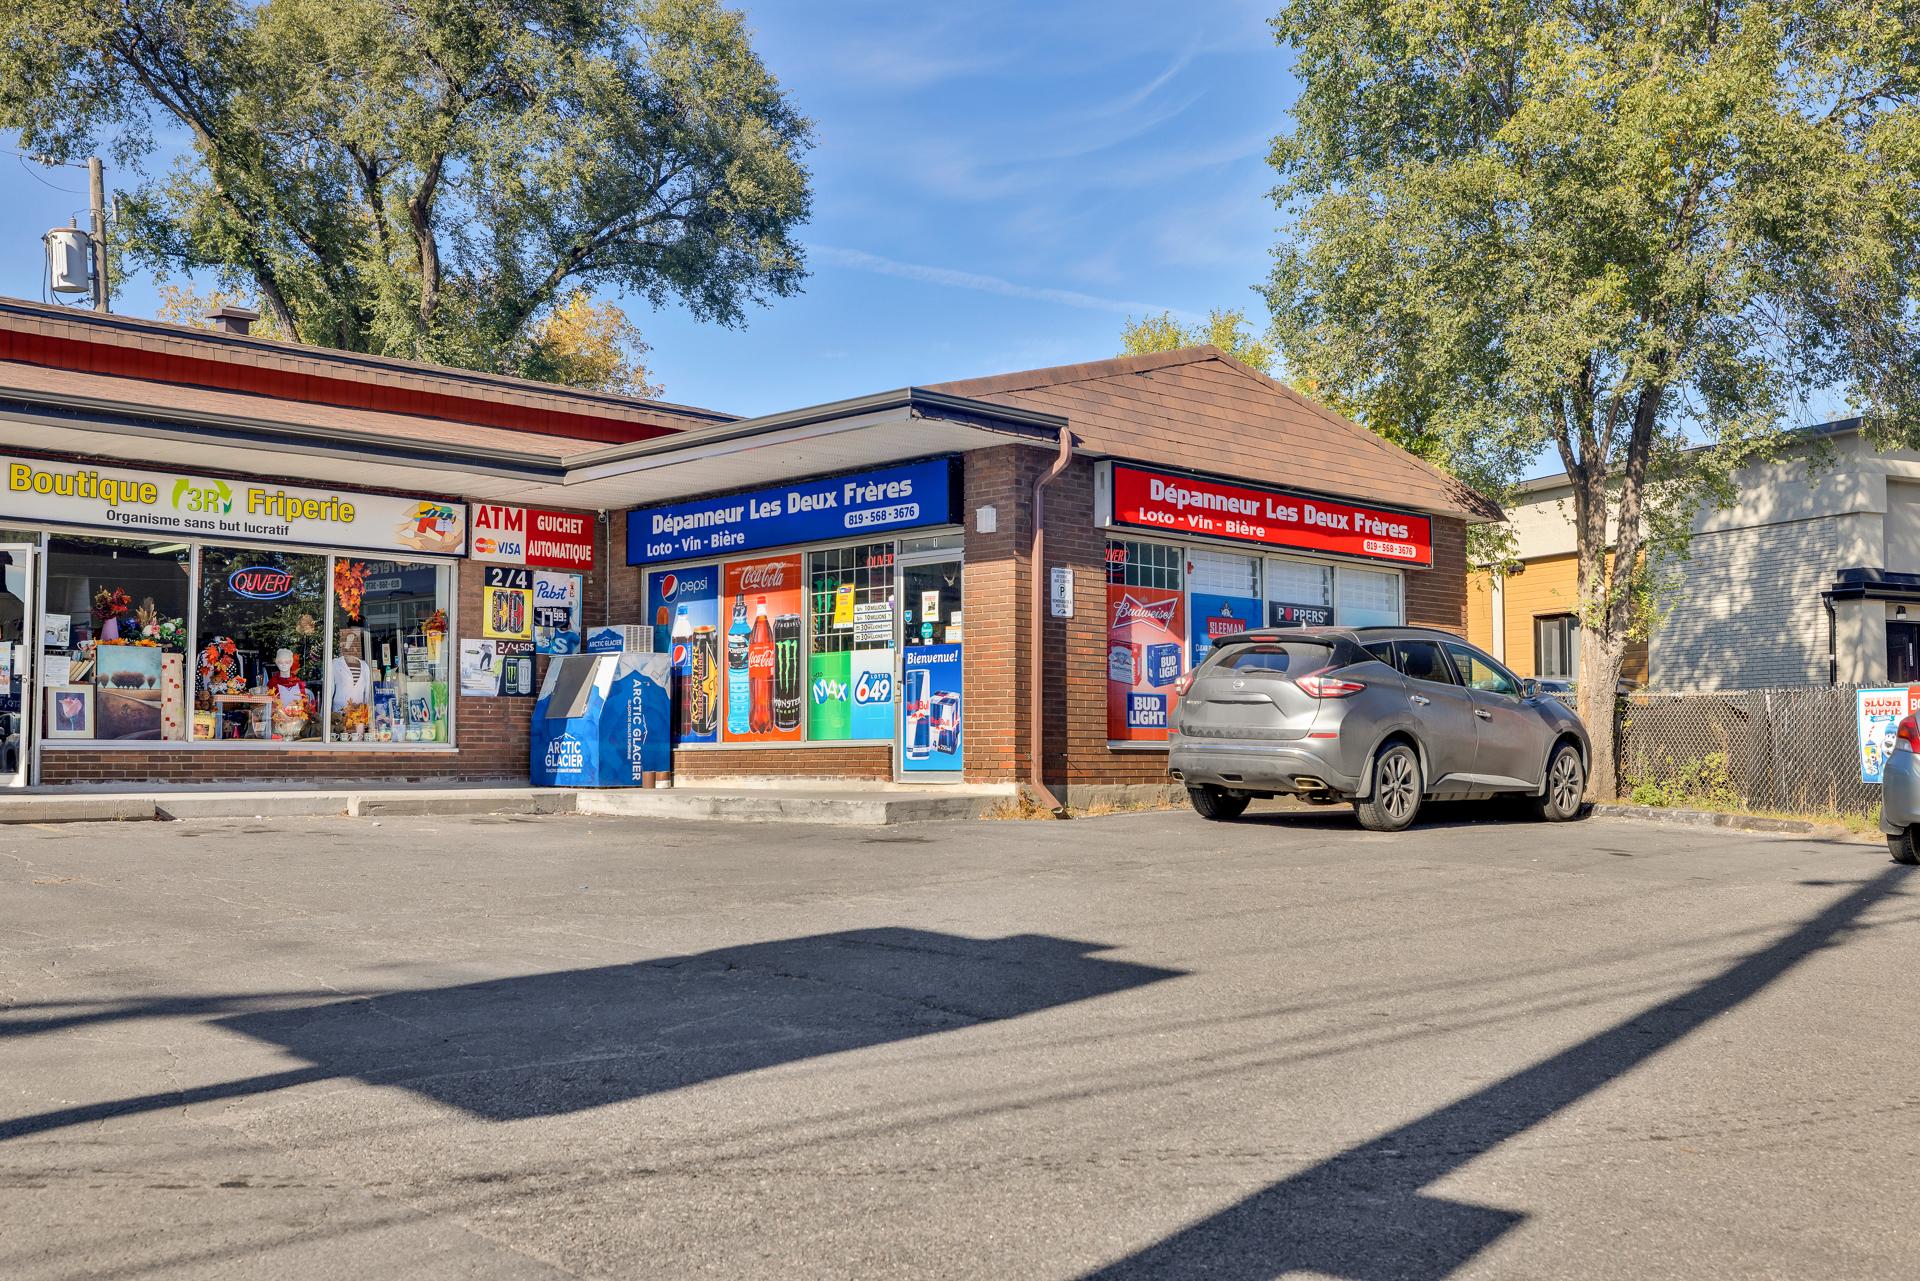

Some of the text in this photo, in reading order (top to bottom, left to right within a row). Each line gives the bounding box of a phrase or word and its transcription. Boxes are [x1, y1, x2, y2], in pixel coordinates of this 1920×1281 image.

[9, 463, 355, 523] Boutique Friperie
[187, 488, 219, 513] 3R
[652, 480, 912, 536] Dépanneur Les Deux Frères
[1150, 478, 1408, 538] Dépanneur Les Deux Frères
[106, 510, 290, 536] Organisme sans but lucratif
[475, 505, 523, 532] ATM
[537, 516, 584, 534] GUICHET
[1139, 507, 1174, 524] Loto
[1188, 514, 1212, 530] Vin
[1226, 520, 1265, 537] Bière
[498, 542, 520, 555] VISA
[528, 540, 592, 564] AUTOMATIQUE
[647, 543, 672, 556] Loto
[682, 536, 701, 552] Vin
[711, 530, 744, 548] Bière
[235, 573, 294, 592] OUVERT
[492, 568, 528, 588] 2/4
[680, 576, 708, 594] pepsi
[536, 580, 568, 600] Pabst
[1114, 602, 1174, 620] Budweiser
[1210, 622, 1244, 634] SLEEMAN
[907, 650, 958, 664] Bienvenue!
[1161, 656, 1176, 668] BUD
[1160, 666, 1178, 678] LIGHT
[813, 679, 847, 704] MAX
[1134, 696, 1160, 710] BUD
[1864, 697, 1902, 707] SLUSH
[1129, 711, 1165, 725] LIGHT
[1865, 707, 1902, 716] PUPPIE
[632, 679, 642, 780] ARCTIC GLACIER
[548, 741, 581, 754] ARCTIC
[545, 754, 583, 768] GLACIER
